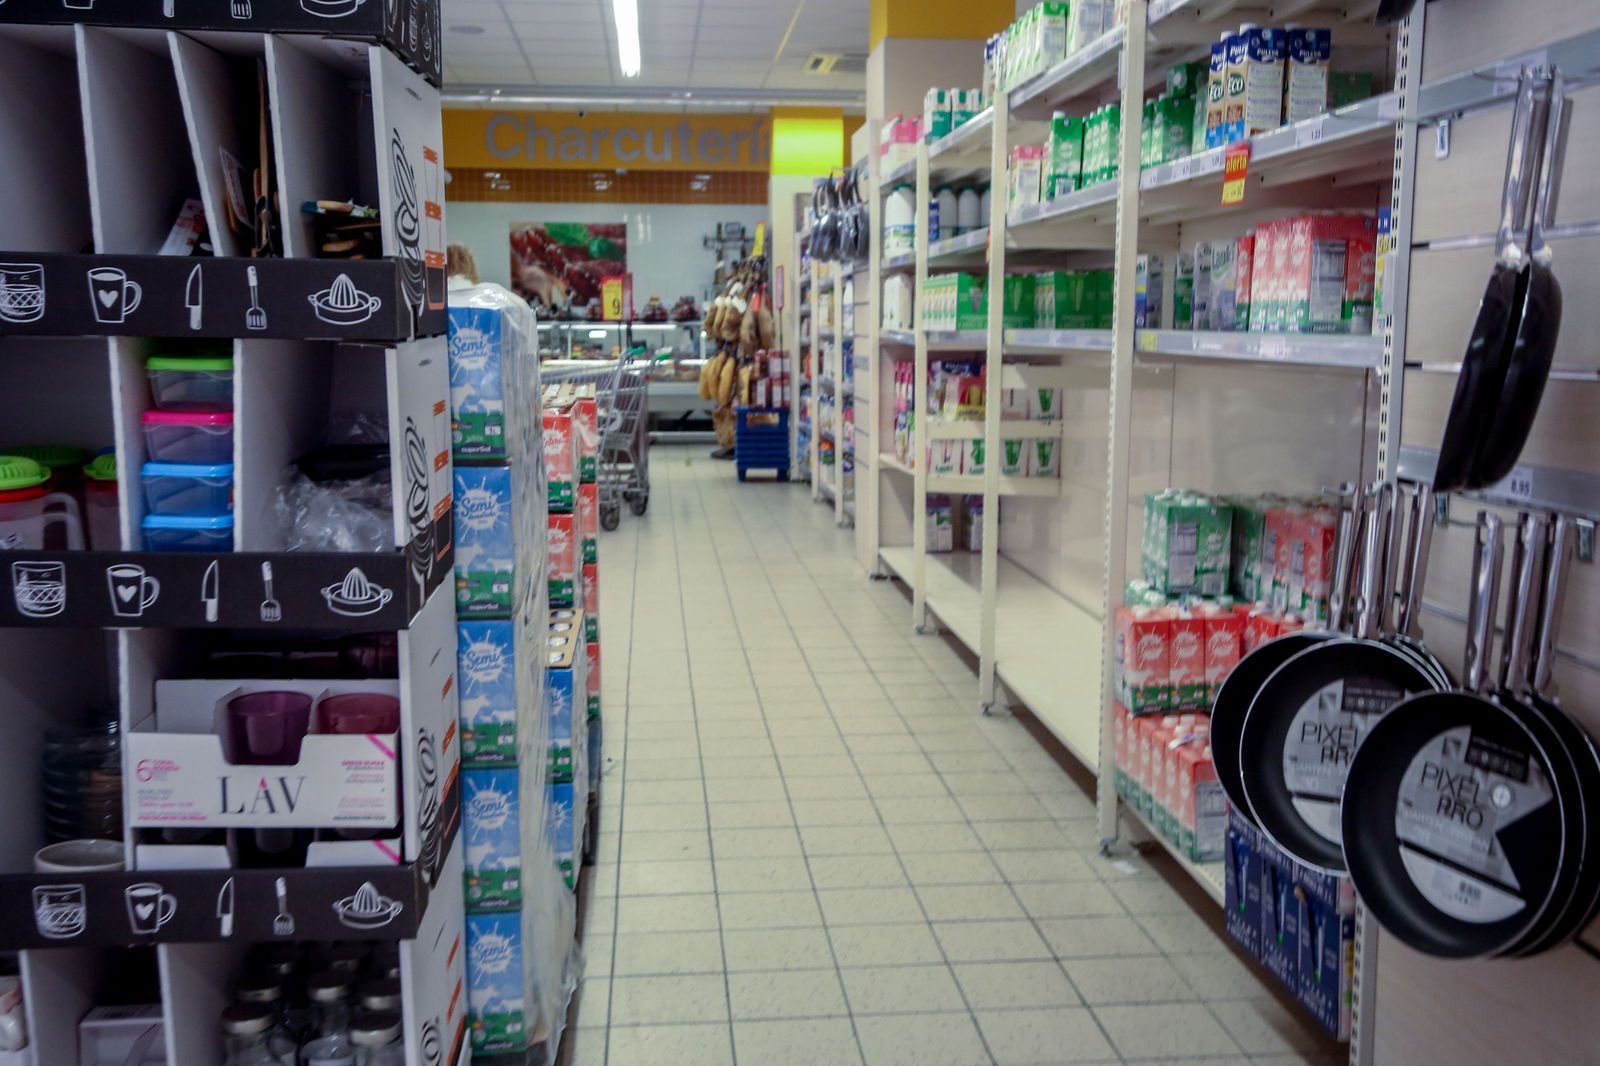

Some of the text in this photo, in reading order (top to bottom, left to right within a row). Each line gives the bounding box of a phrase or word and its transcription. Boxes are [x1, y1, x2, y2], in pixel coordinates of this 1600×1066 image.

[485, 114, 770, 164] Charcuterí
[1226, 154, 1247, 172] oferta
[452, 335, 486, 357] Semi
[460, 495, 496, 517] Semi
[1302, 721, 1359, 749] PIXEL
[1321, 745, 1356, 769] PR
[217, 775, 307, 814] LAV
[1421, 761, 1482, 804] PIXEL
